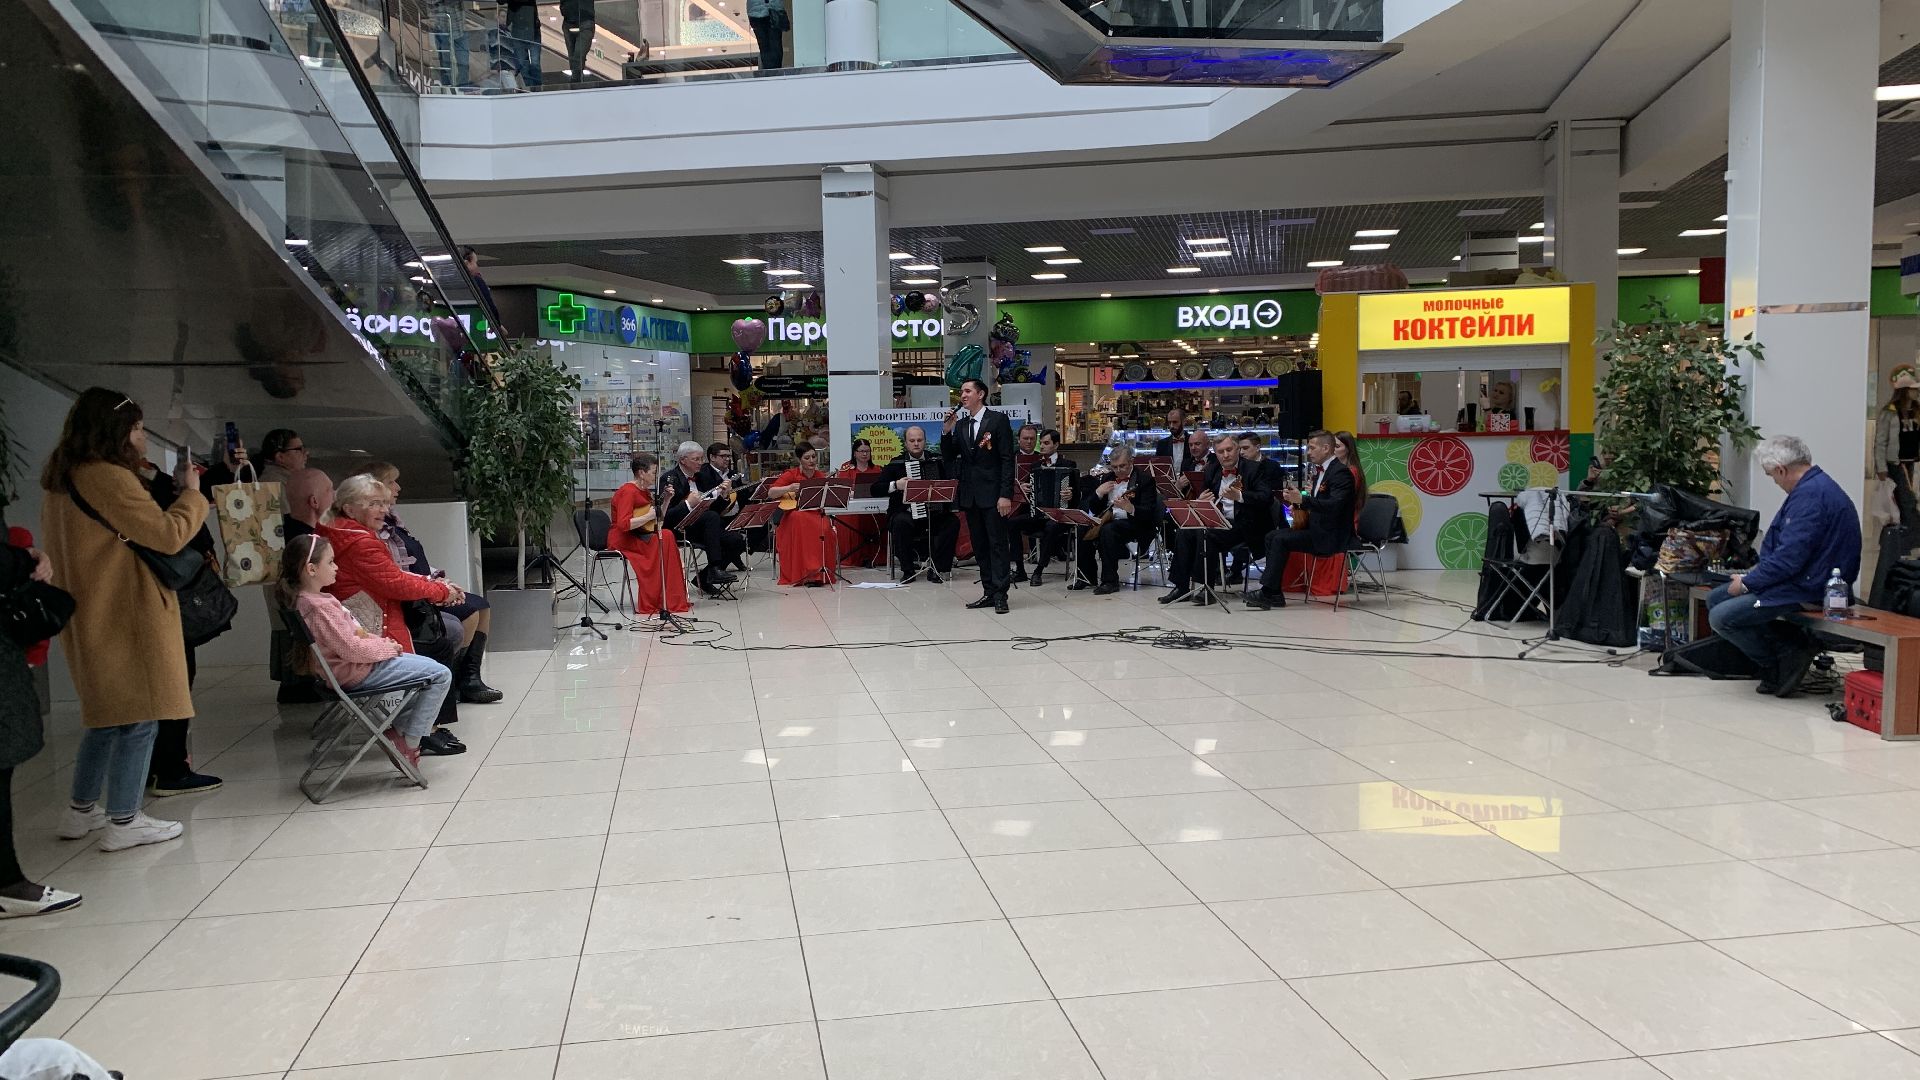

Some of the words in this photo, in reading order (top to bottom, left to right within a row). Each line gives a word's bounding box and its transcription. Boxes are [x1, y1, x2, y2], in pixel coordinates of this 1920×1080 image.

[640, 315, 690, 342] АПТЕКА
[1178, 304, 1251, 329] ВХОД
[855, 412, 927, 421] КОМФОРТНЫЕ
